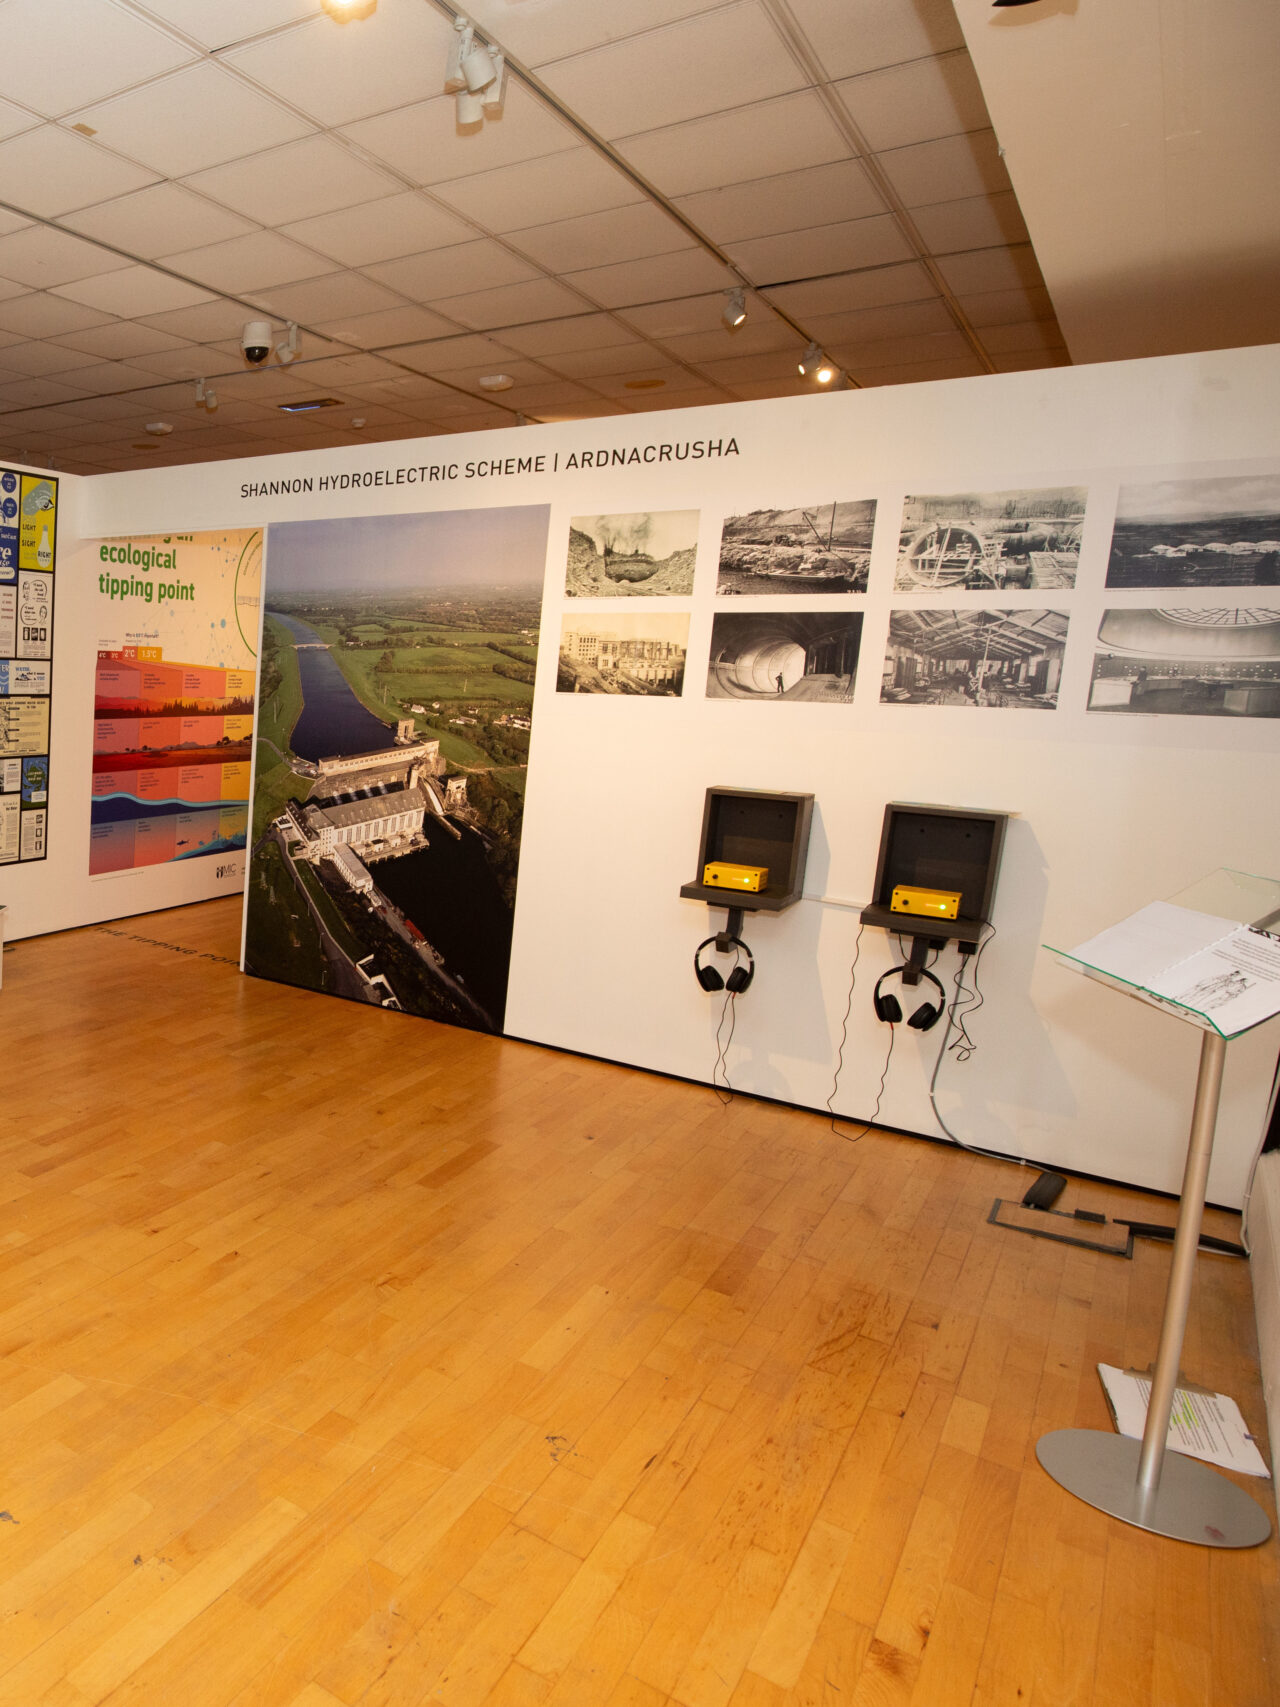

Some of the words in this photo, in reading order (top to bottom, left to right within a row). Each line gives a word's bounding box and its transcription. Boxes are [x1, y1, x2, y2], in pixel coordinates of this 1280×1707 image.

[240, 478, 313, 498] SHANNON
[319, 463, 459, 491] HYDROELECTRIC
[465, 455, 546, 478] SCHEME
[565, 437, 740, 470] ARDNACRUSHA
[100, 543, 176, 572] ecological
[99, 572, 153, 603] tipping
[158, 579, 195, 604] point
